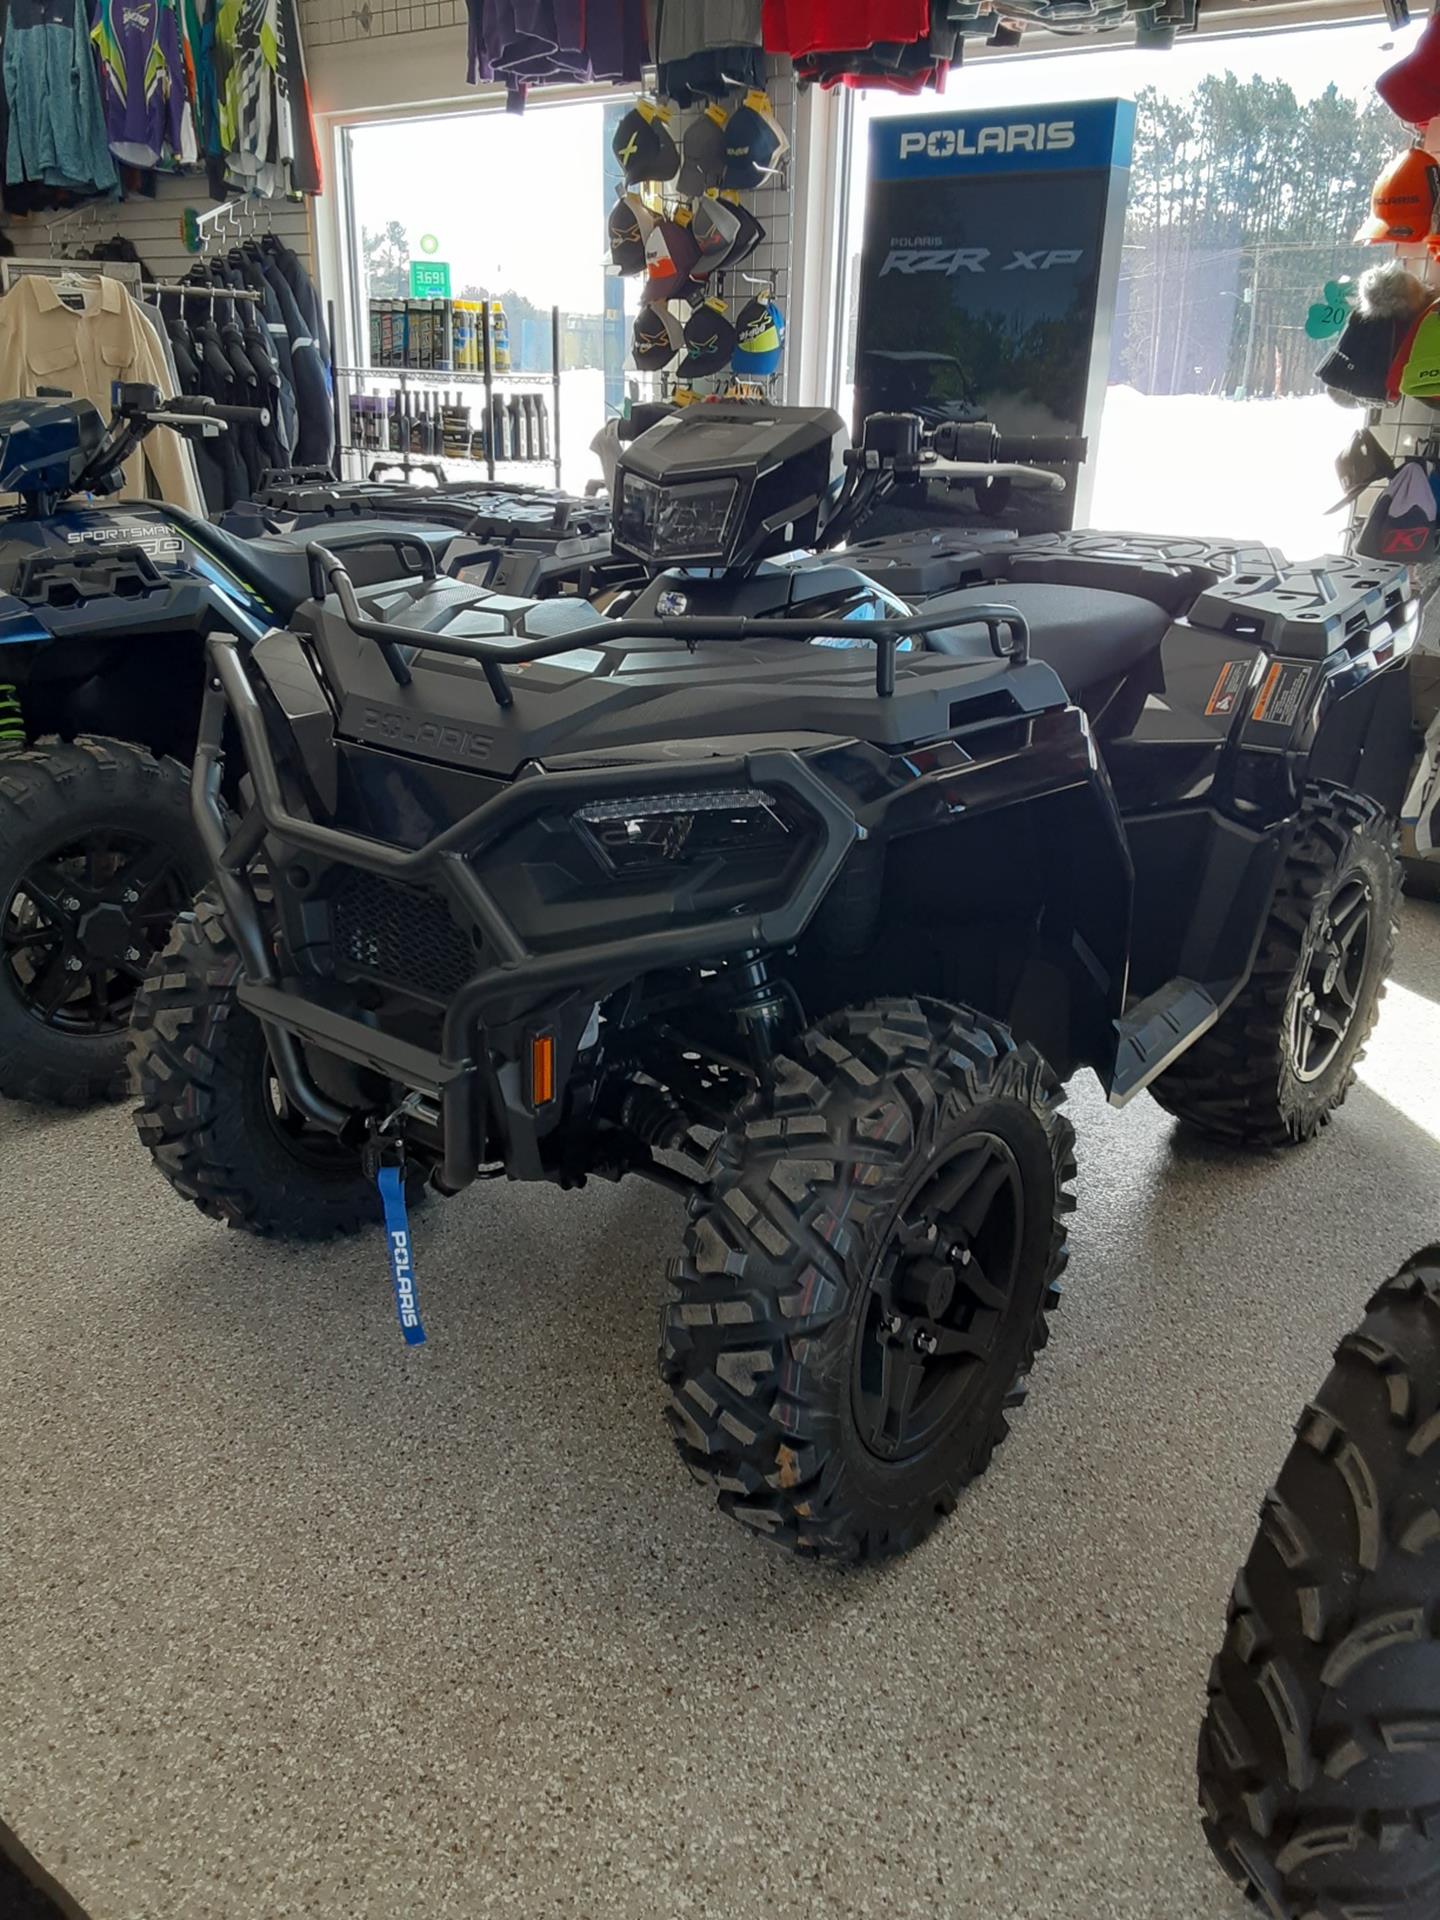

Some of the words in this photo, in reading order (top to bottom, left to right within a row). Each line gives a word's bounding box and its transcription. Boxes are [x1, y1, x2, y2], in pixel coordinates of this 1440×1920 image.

[900, 120, 1076, 159] POLARIS
[890, 236, 943, 248] POLARIS
[878, 248, 991, 278] RZR
[1002, 250, 1084, 271] XP
[67, 526, 176, 544] SPORTSMAN
[363, 707, 495, 760] POLARIS
[391, 1231, 418, 1328] POLARIS
